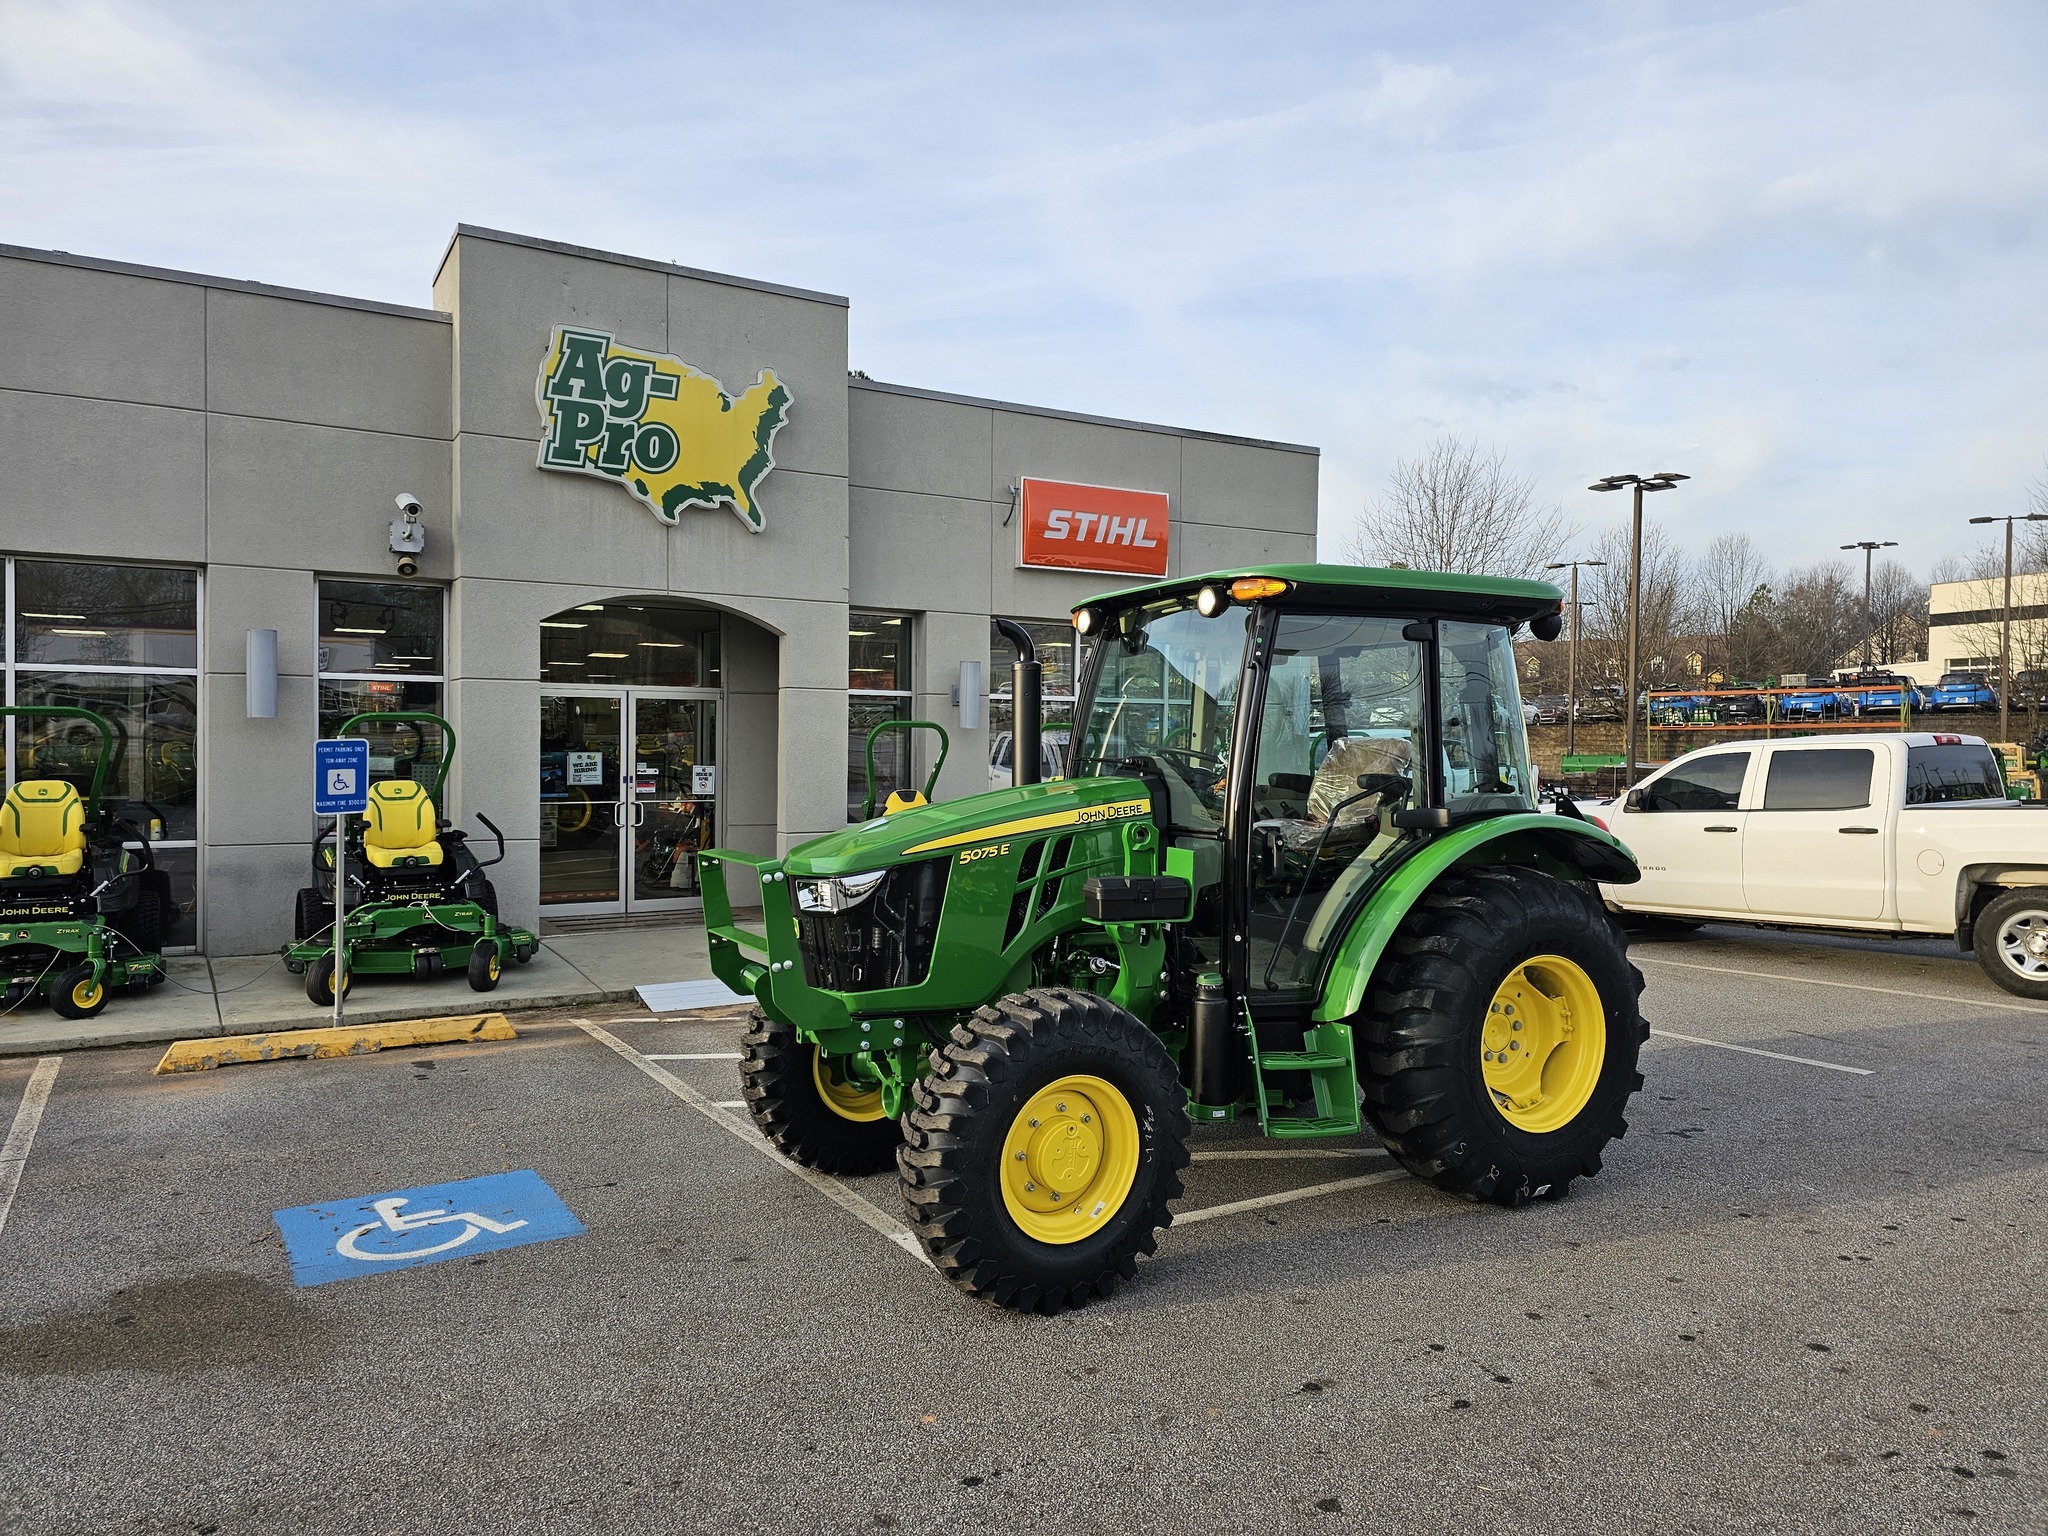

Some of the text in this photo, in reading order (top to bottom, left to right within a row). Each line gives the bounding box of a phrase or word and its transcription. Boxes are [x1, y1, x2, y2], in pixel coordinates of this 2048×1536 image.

[543, 330, 681, 421] Ag-
[544, 399, 681, 474] Pro
[1043, 508, 1157, 548] STIHL
[1074, 804, 1143, 825] JOHN DEERE
[959, 843, 1011, 865] 5075 E
[411, 892, 441, 900] DEERE
[0, 906, 69, 916] JOHN DEERE
